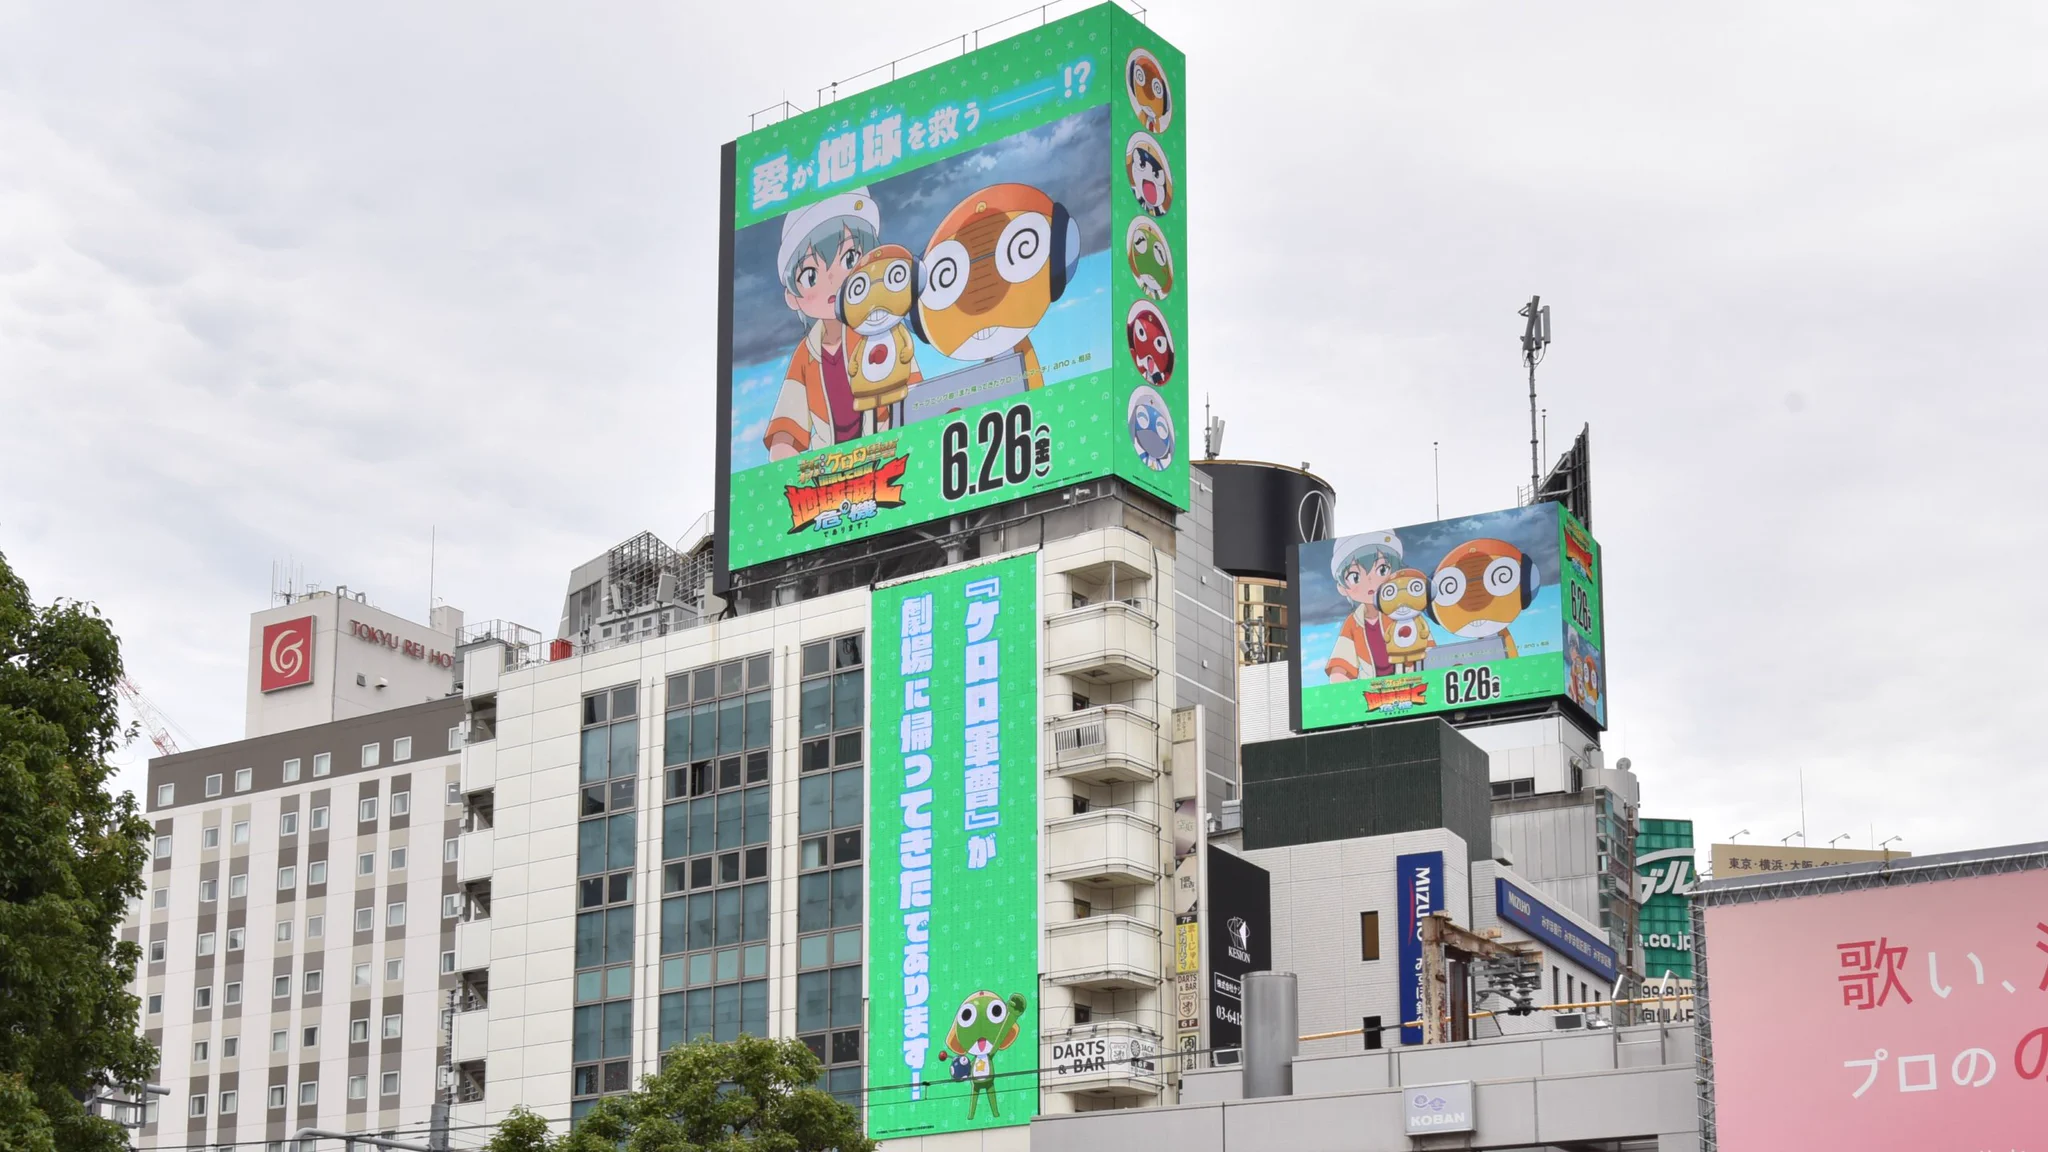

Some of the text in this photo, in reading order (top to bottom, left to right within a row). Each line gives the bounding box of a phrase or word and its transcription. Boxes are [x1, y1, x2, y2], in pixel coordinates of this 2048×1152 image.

[942, 404, 1032, 501] 6.26
[350, 619, 398, 649] TOKYU
[403, 639, 424, 659] REI
[1445, 667, 1490, 704] 6.26
[1508, 891, 1531, 916] MIZUHO
[1228, 945, 1250, 964] KESION
[1178, 973, 1197, 983] DARTS
[1185, 983, 1197, 991] BAR
[1053, 1040, 1105, 1060] DARTS
[1058, 1057, 1106, 1075] & BAR
[1411, 1112, 1465, 1127] KOBAN
